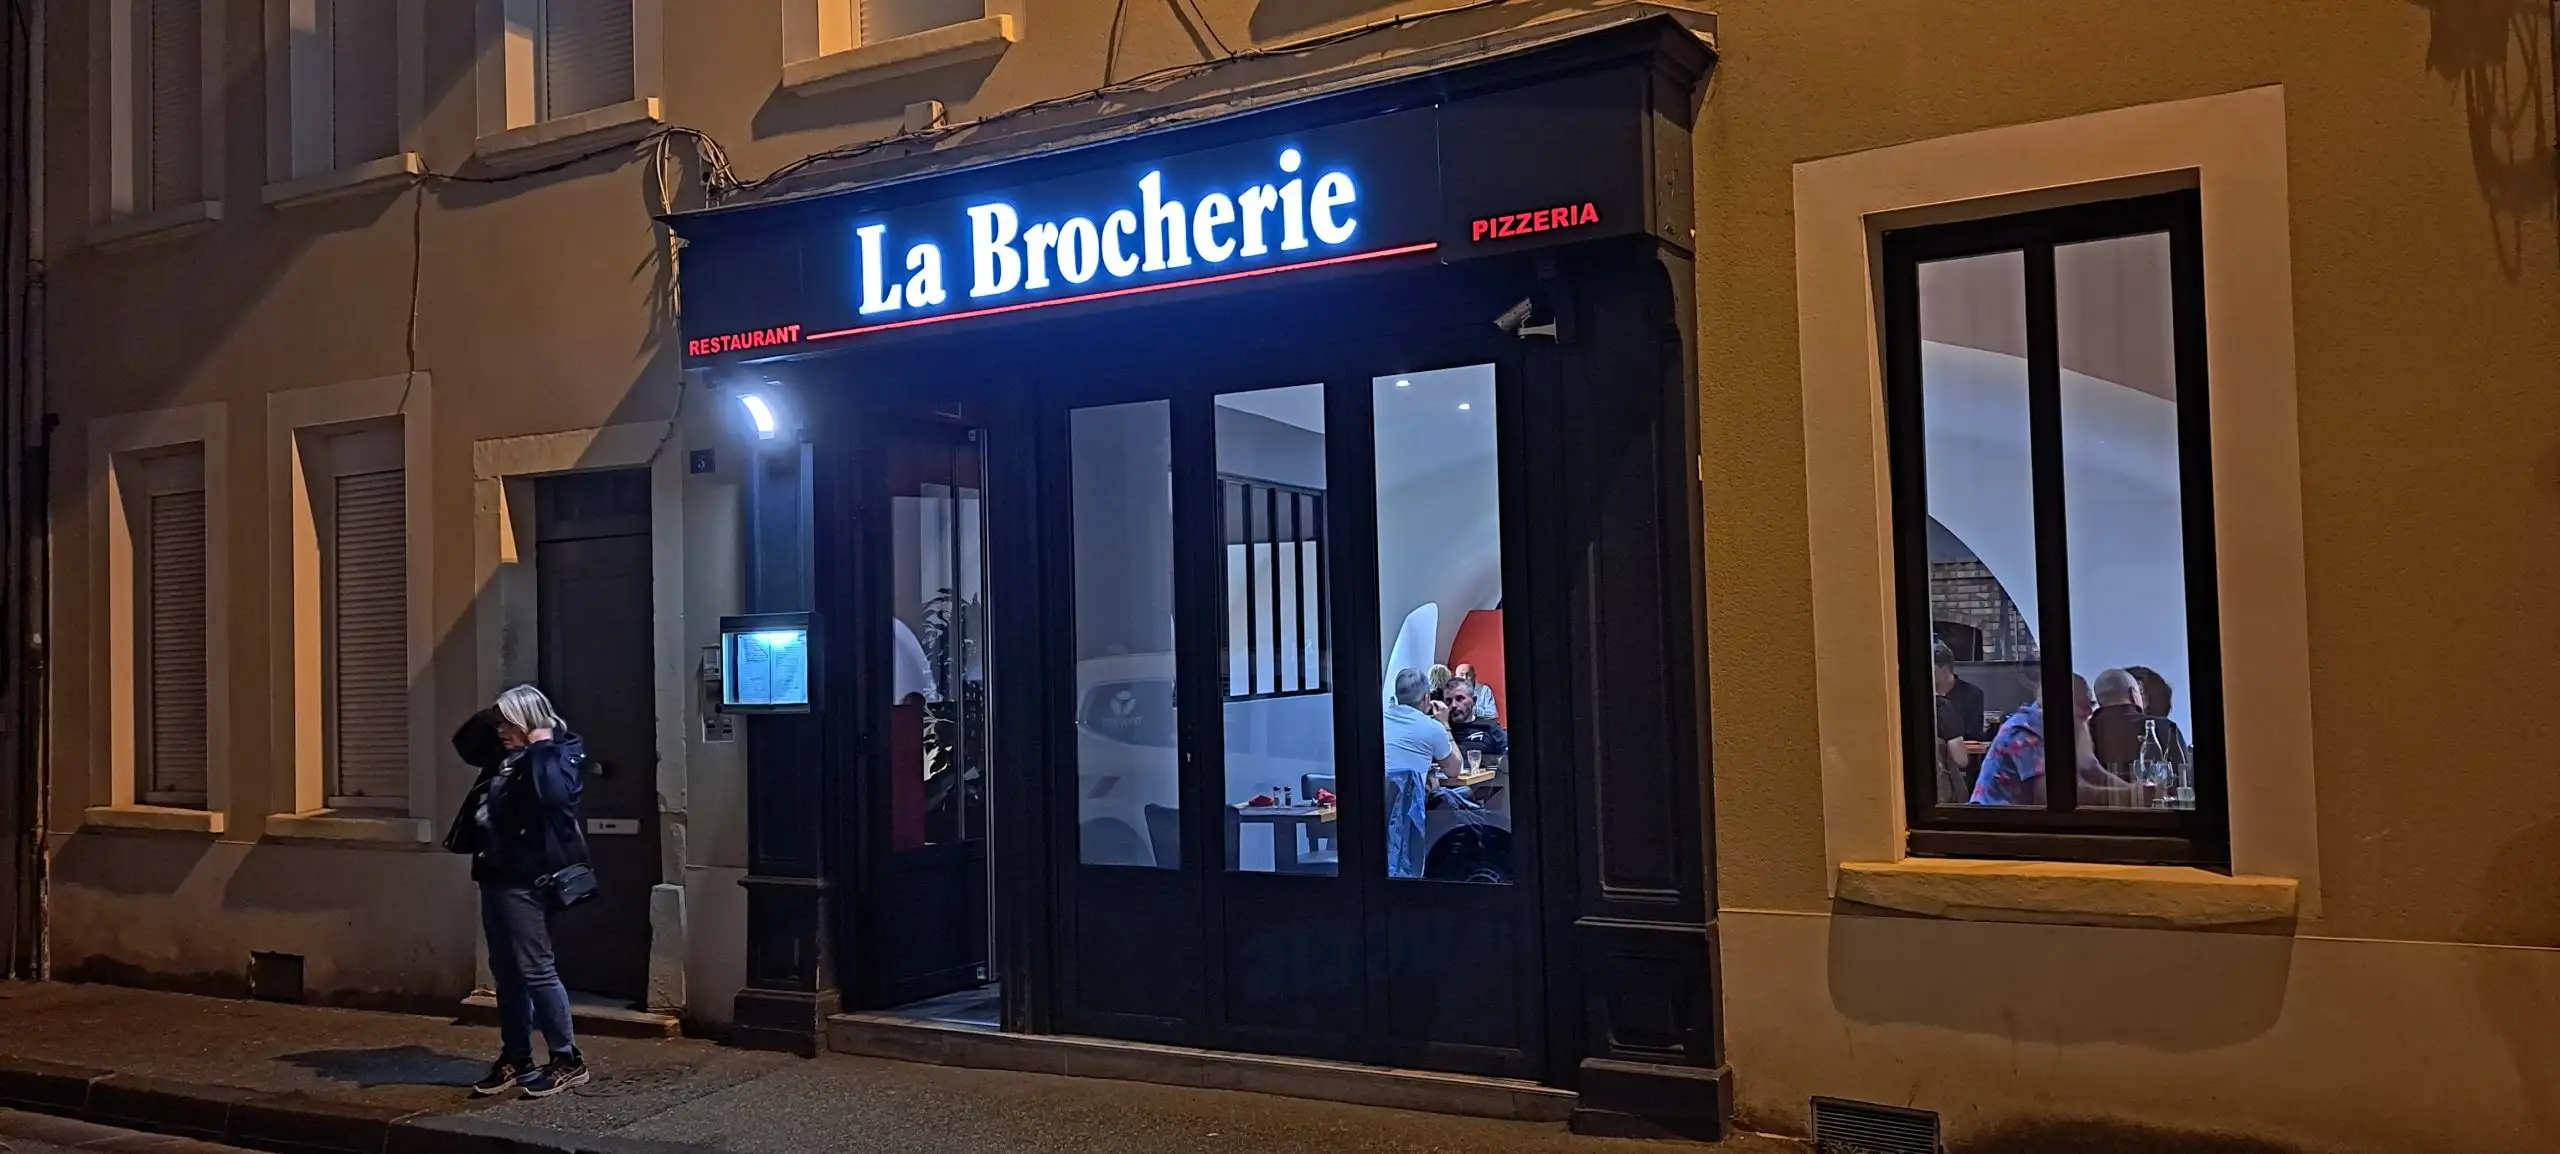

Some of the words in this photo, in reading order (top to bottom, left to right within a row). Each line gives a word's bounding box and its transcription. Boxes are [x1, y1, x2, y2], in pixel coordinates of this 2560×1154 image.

[856, 222, 946, 315] La
[967, 148, 1358, 299] Brocherie
[1472, 202, 1600, 242] PIZZERIA
[688, 324, 800, 356] RESTAURANT
